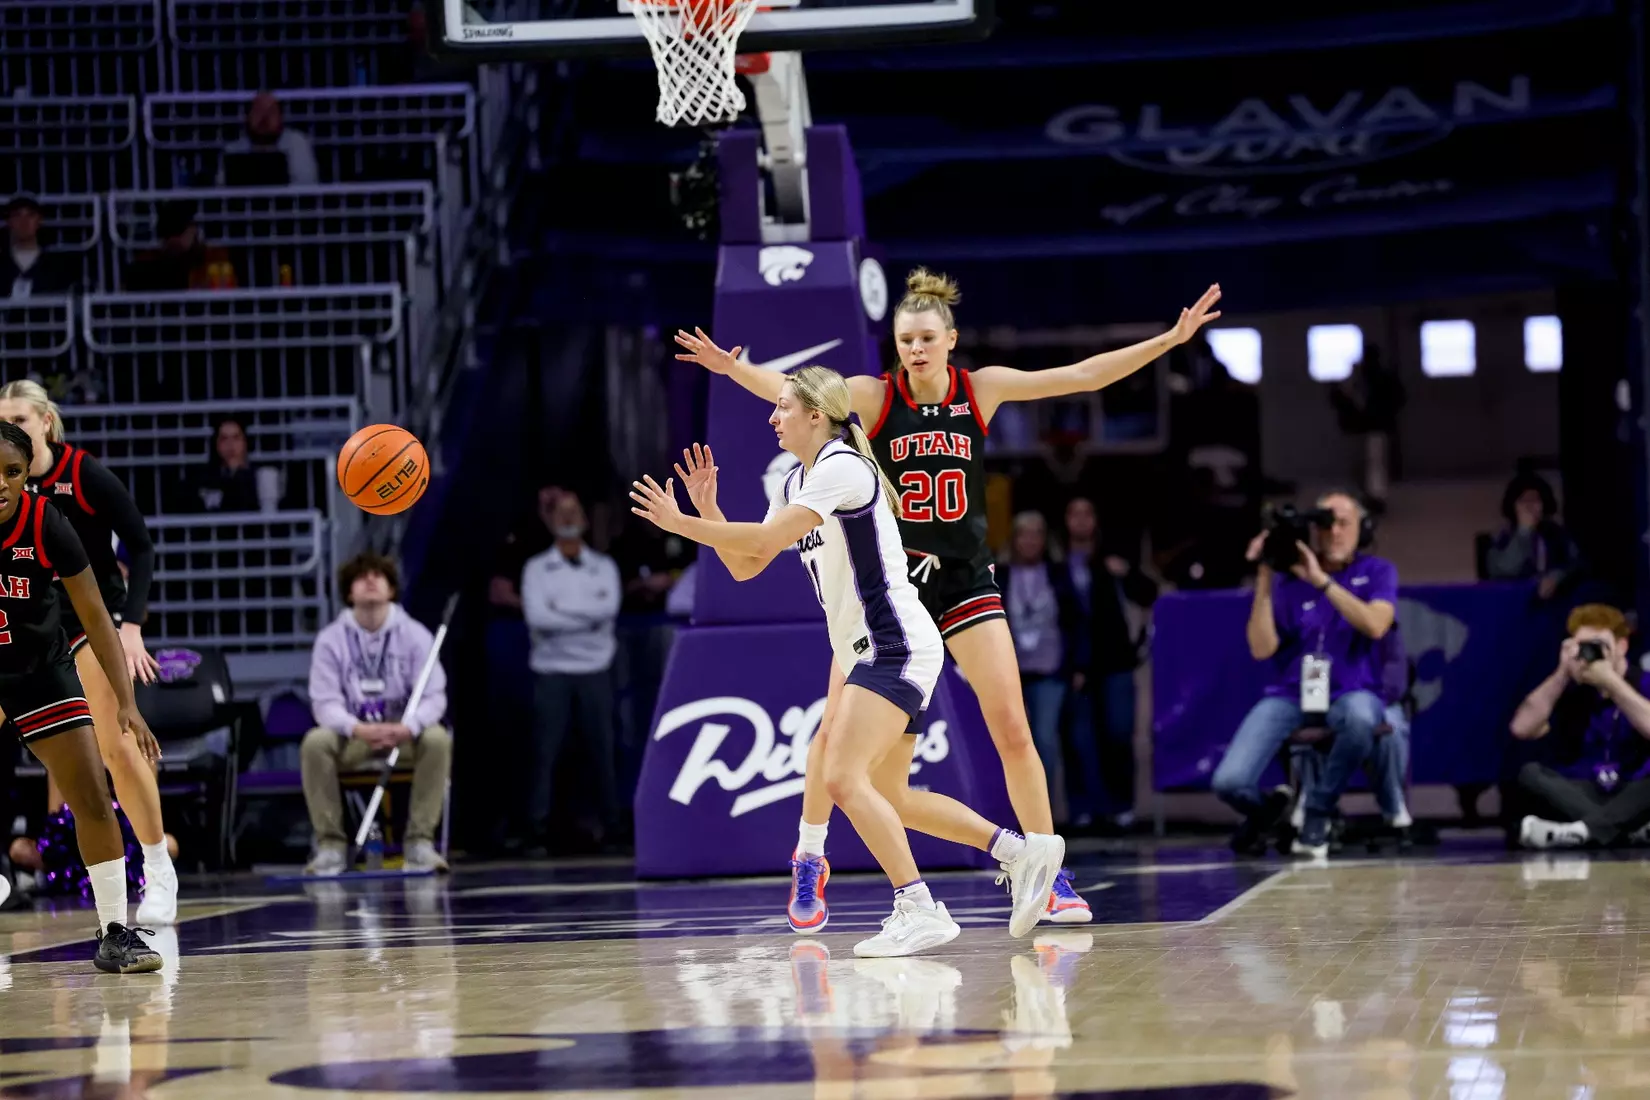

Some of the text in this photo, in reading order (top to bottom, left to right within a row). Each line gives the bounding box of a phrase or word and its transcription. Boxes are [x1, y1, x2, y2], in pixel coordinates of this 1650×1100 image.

[1045, 75, 1531, 144] GLAVAN
[890, 431, 972, 462] UTAH
[375, 459, 418, 499] ELITE
[899, 469, 968, 522] 20
